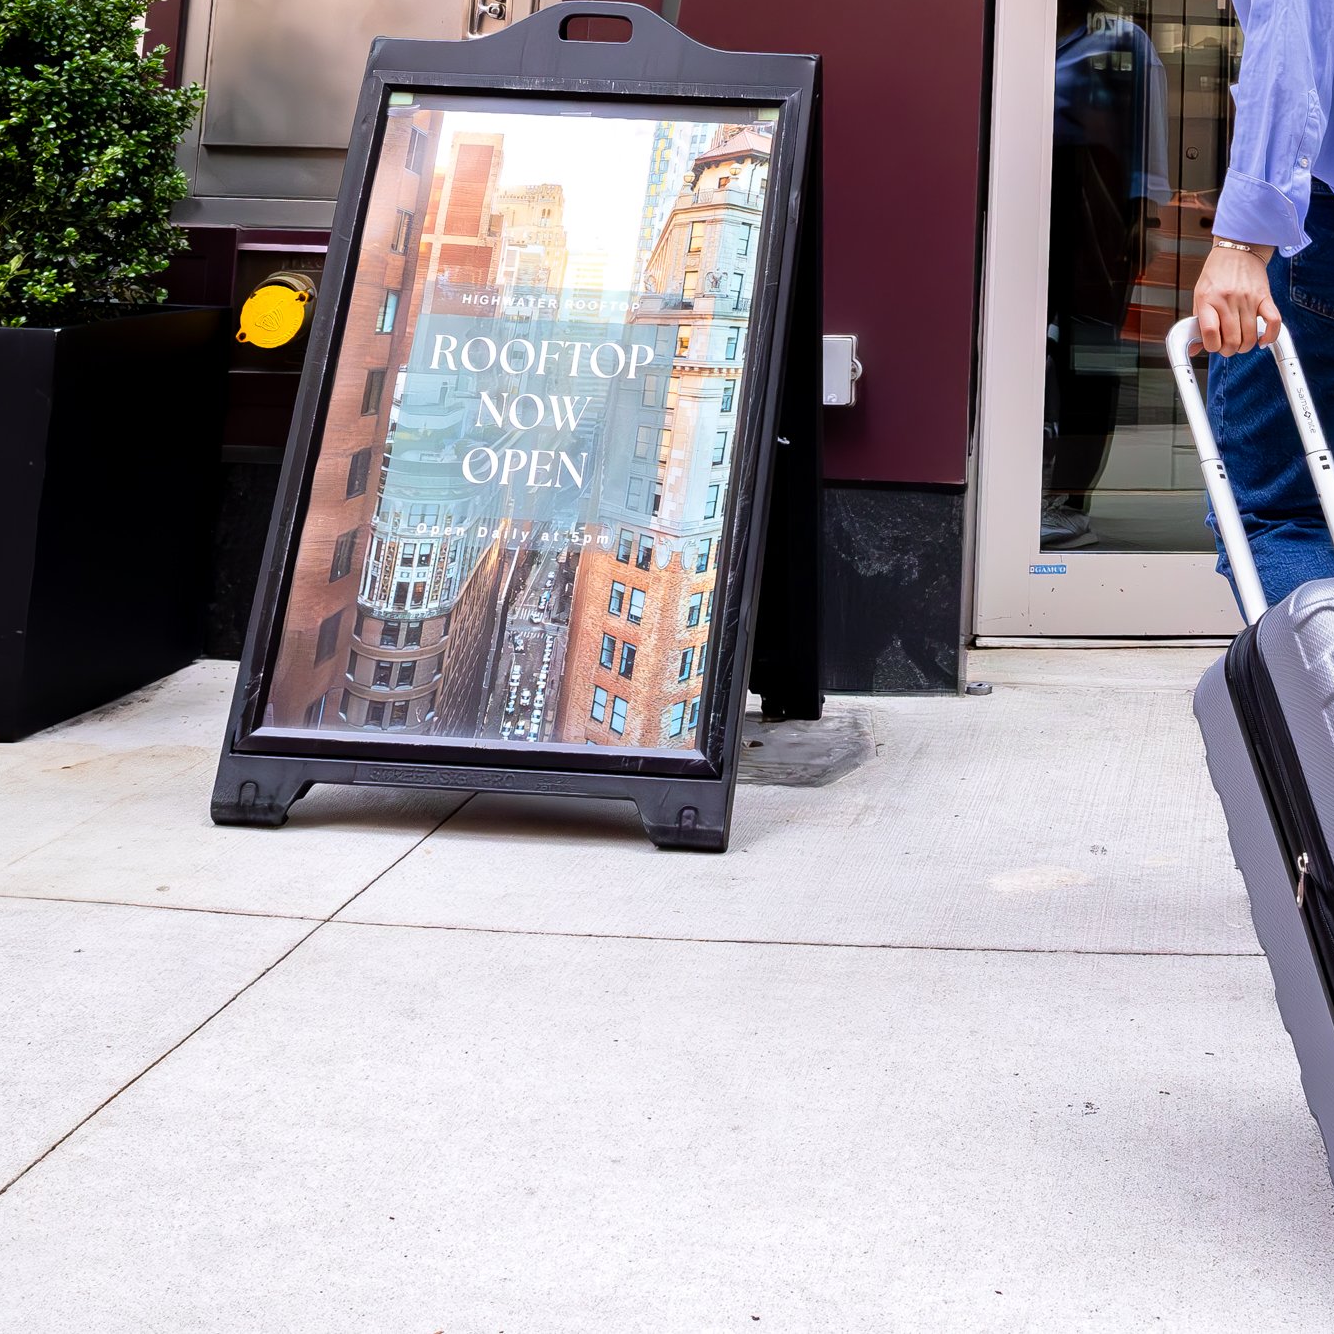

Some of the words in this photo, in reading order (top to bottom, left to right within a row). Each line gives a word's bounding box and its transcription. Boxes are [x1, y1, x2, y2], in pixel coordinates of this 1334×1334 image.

[462, 294, 558, 309] HIGHWATER
[564, 299, 641, 312] ROOFTOP
[429, 334, 655, 379] ROOFTOP
[475, 391, 592, 432] NOW
[462, 447, 587, 489] OPEN
[416, 523, 466, 537] Open
[477, 527, 530, 543] Daily
[541, 530, 560, 542] at
[571, 531, 610, 546] 5pm
